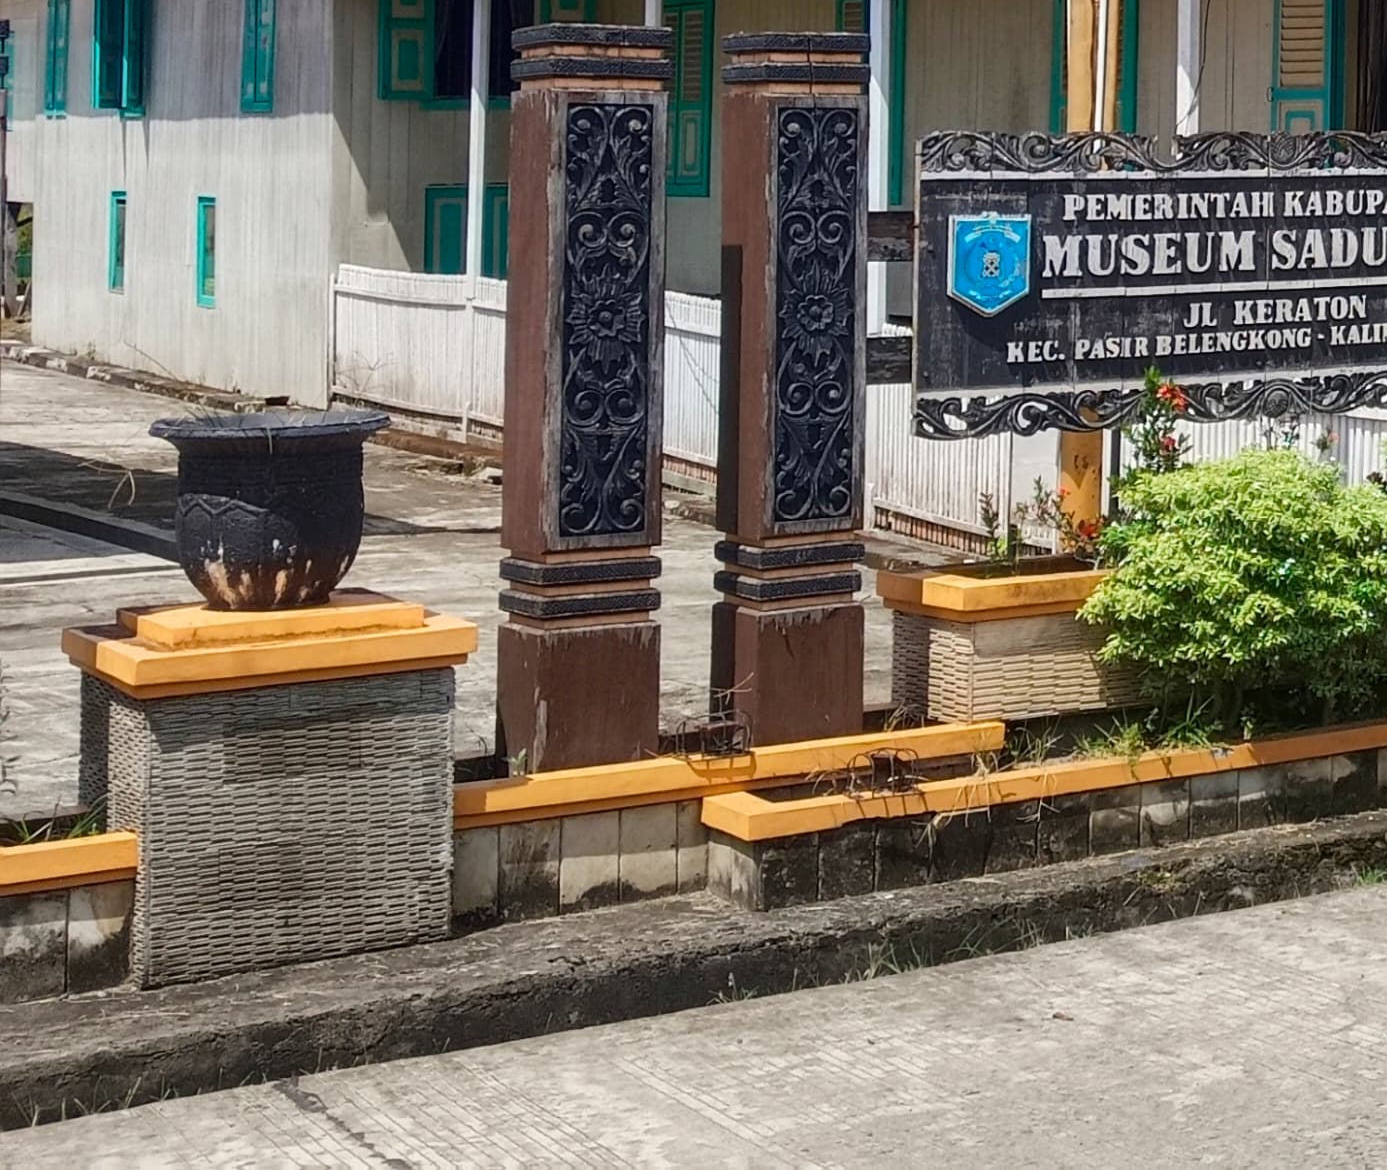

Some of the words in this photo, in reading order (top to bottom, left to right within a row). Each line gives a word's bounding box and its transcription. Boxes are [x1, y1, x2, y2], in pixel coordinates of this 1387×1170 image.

[1062, 190, 1275, 221] PEMERINTAH
[1042, 228, 1256, 279] MUSEUM
[1183, 302, 1217, 329] JL
[1233, 293, 1368, 326] KERATON
[1006, 339, 1066, 364] KEC.
[1074, 334, 1149, 361] PASIR
[1156, 327, 1311, 357] BELENGKONG
